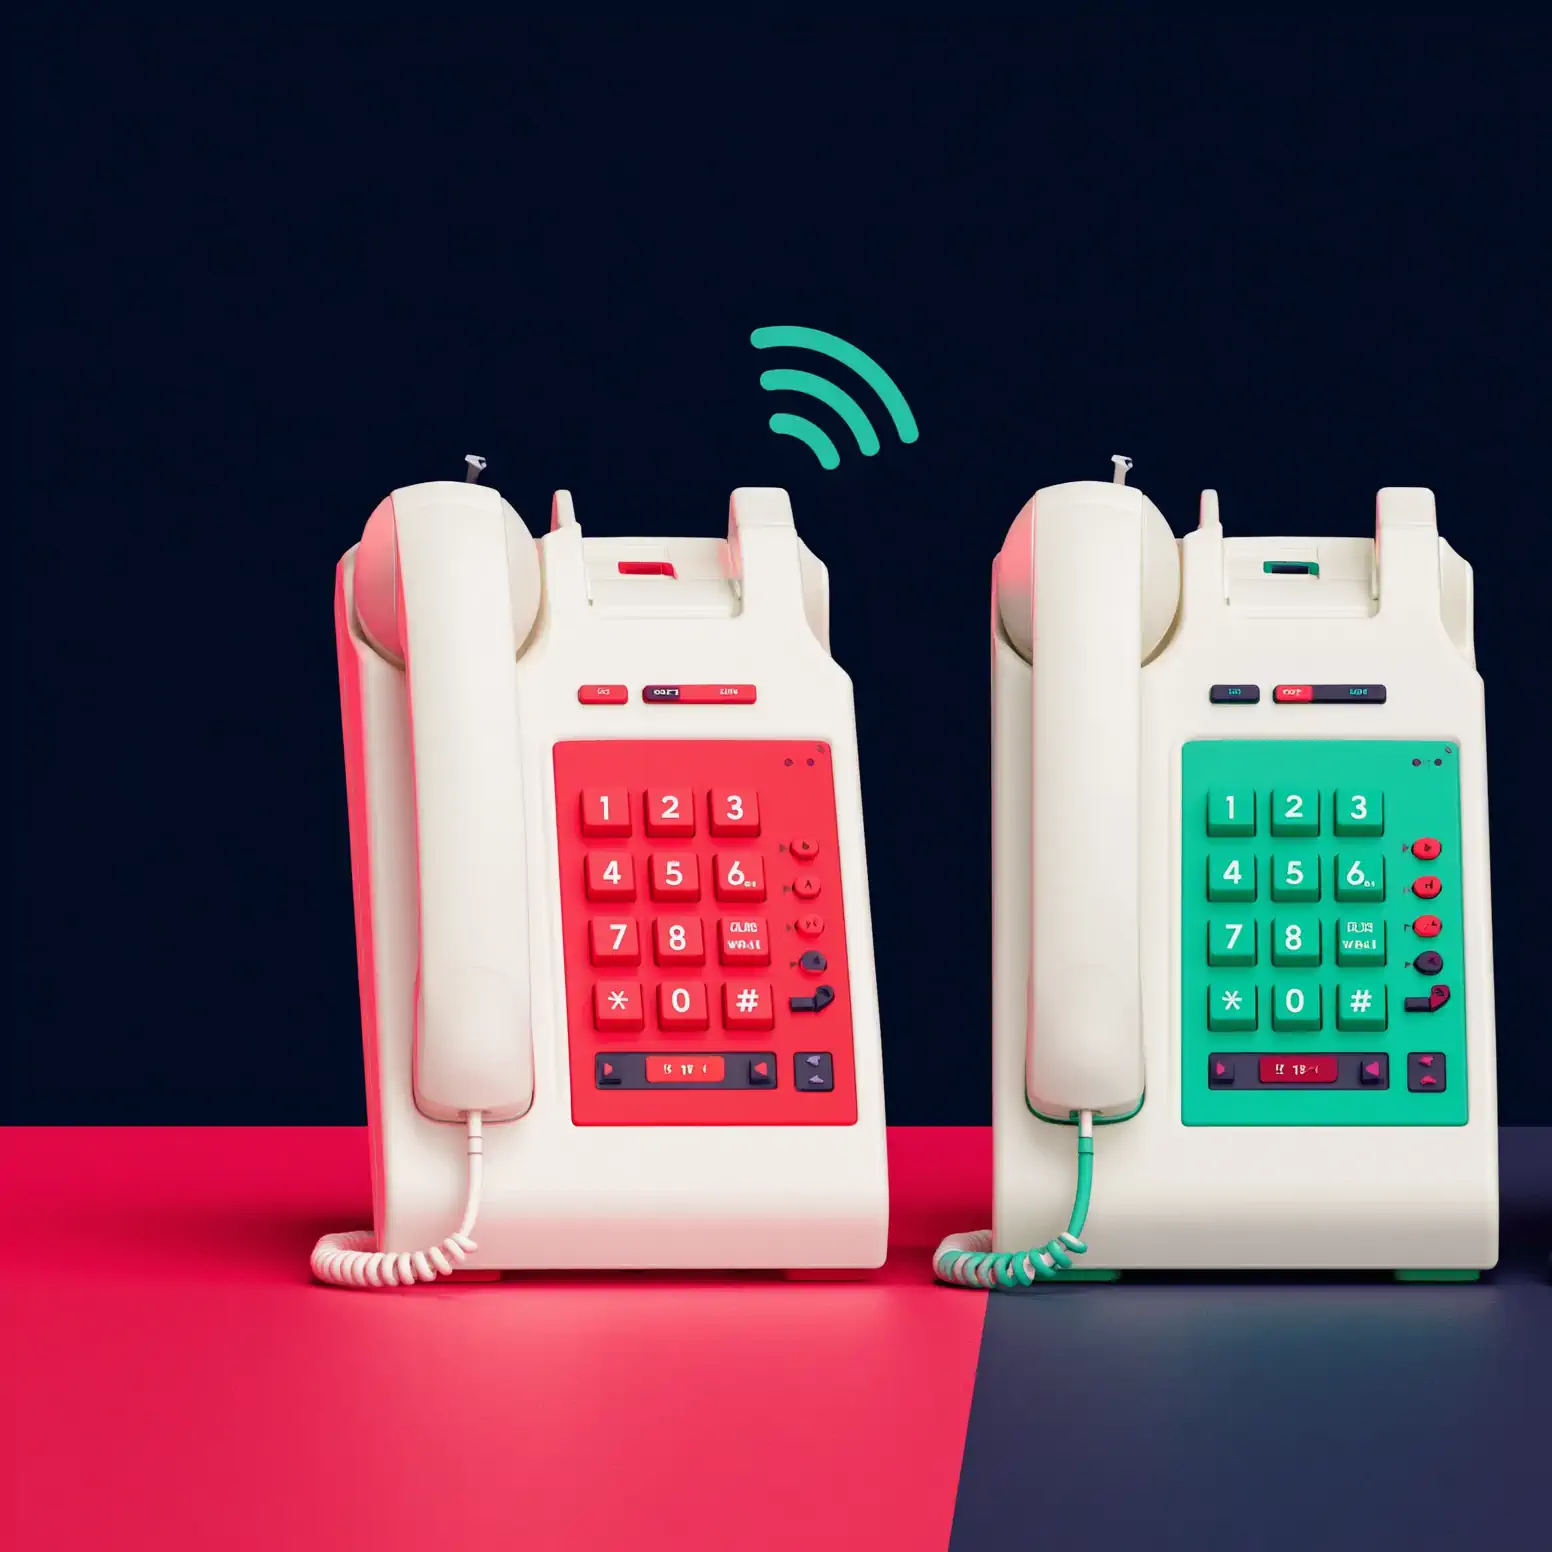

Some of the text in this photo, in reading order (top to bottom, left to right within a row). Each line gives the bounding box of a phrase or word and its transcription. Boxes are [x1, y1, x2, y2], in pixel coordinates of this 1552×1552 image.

[600, 795, 744, 820] 1 2 3
[1225, 795, 1368, 820] 1 2 3
[602, 860, 745, 886] 4 5 6
[1223, 860, 1365, 886] 4 5 6
[609, 923, 686, 951] 7 8
[1225, 924, 1302, 950] 7 8
[671, 988, 690, 1013] 0
[735, 988, 759, 1013] #
[1285, 988, 1305, 1013] 0
[1349, 989, 1372, 1013] #
